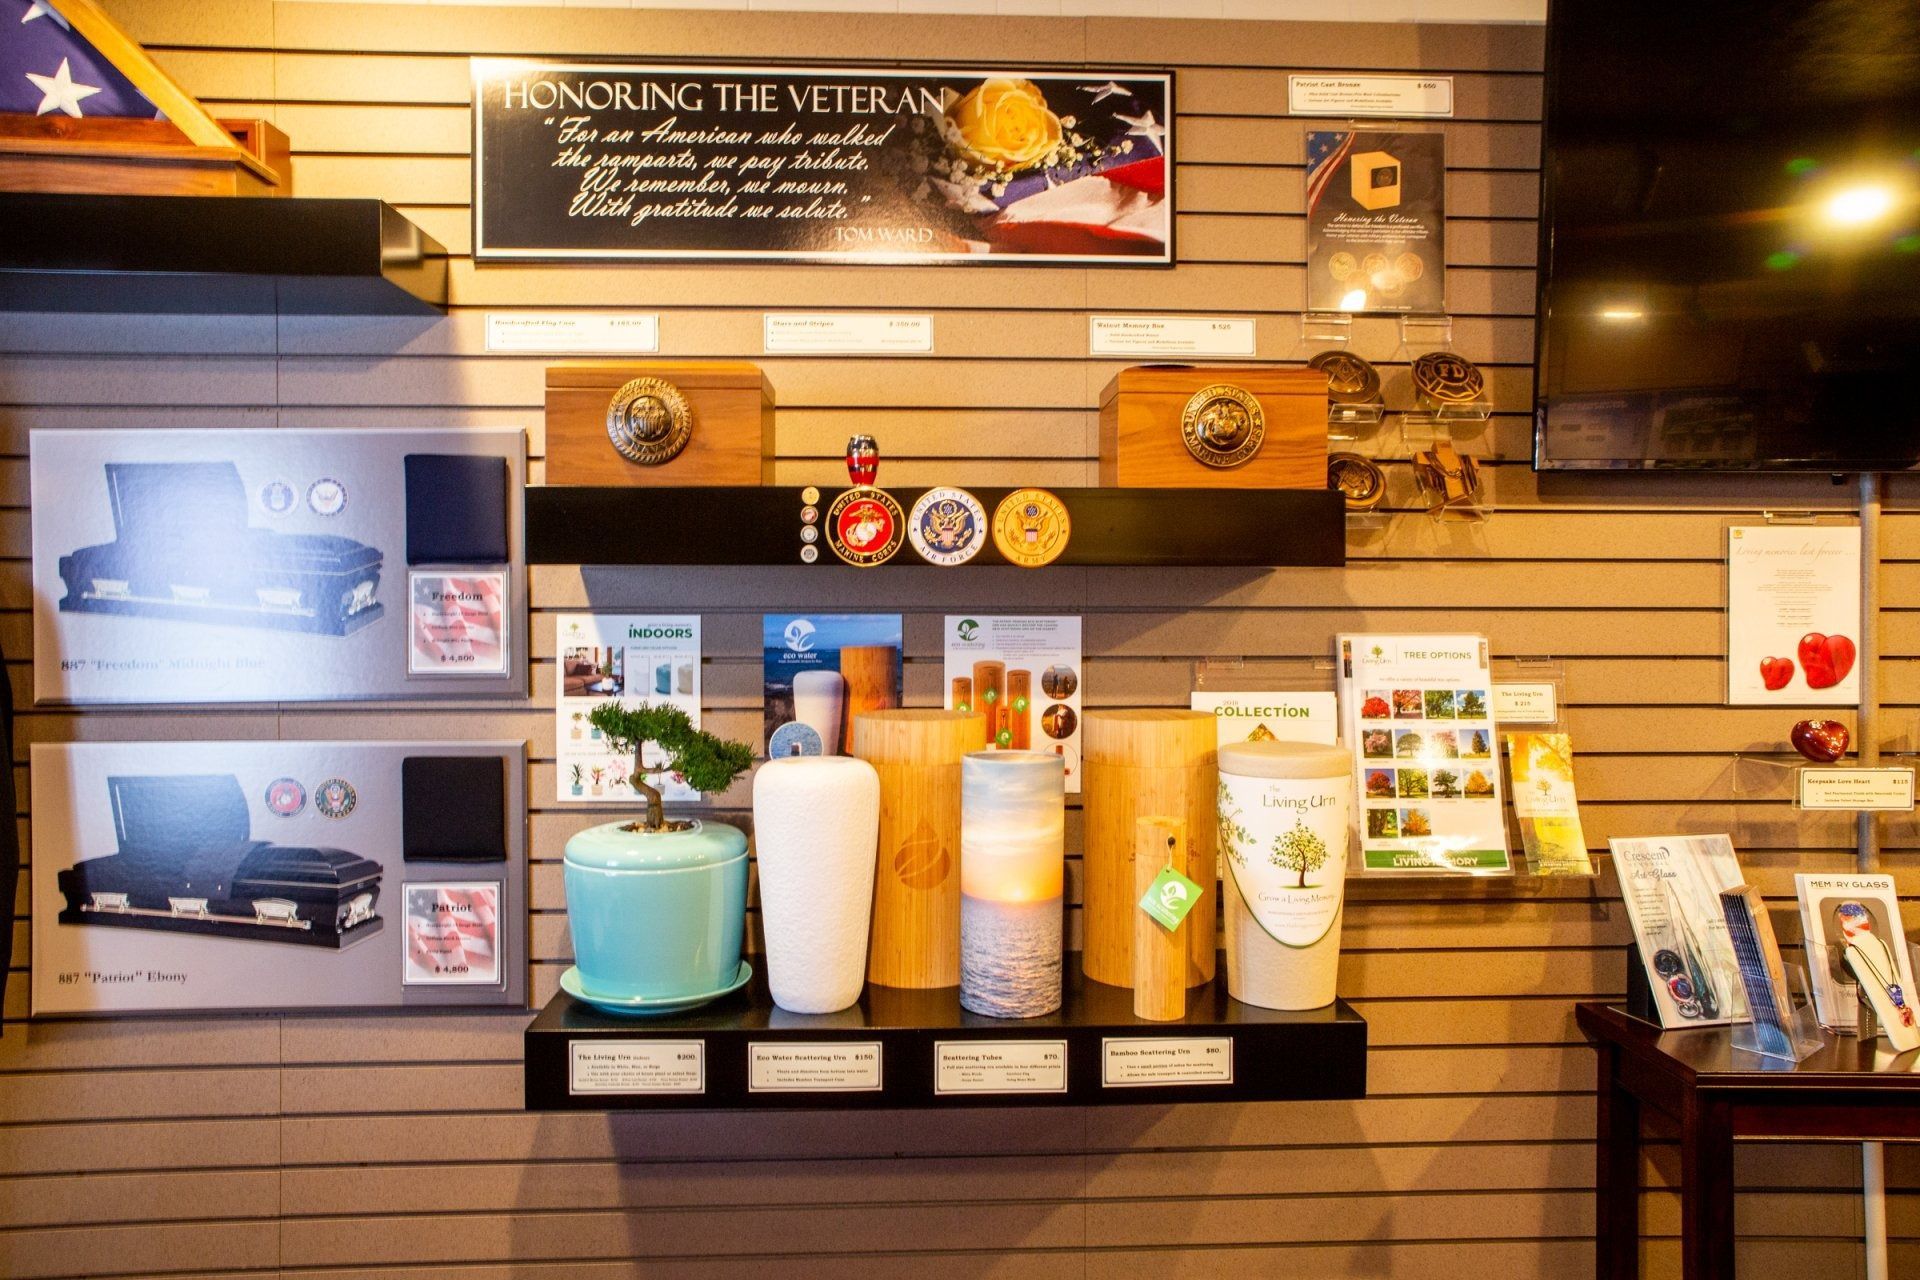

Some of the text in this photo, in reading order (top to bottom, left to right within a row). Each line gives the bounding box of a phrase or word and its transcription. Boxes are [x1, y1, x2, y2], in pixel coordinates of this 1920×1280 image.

[504, 80, 945, 115] HONORING THE VETERAN
[600, 130, 634, 144] an
[641, 116, 752, 146] American
[754, 121, 802, 146] who
[806, 122, 896, 147] walked
[552, 144, 869, 179] the ramparts, we pay tribute.
[580, 166, 849, 196] We remember, we mourn.
[568, 191, 636, 217] With
[631, 194, 738, 227] gratitude
[740, 204, 770, 219] we
[1333, 212, 1418, 225] Honoring the Veteran
[834, 227, 933, 243] TOM WARD
[1122, 322, 1150, 330] Memory
[1224, 386, 1259, 415] STATES
[1187, 429, 1262, 464] MARINE CORPS
[833, 491, 898, 516] UNITED STATES
[835, 539, 897, 563] MARINE CORPS
[942, 544, 978, 563] FORCE
[432, 591, 483, 601] Freedom
[1403, 651, 1472, 660] TREE OPTIONS
[61, 660, 86, 671] 887
[1263, 794, 1336, 814] Living Urn
[1393, 857, 1430, 867] LIVING
[1623, 850, 1667, 861] Crescent
[1648, 868, 1677, 880] Glass
[431, 903, 472, 912] Patriot
[58, 973, 80, 985] 887
[147, 971, 188, 985] Ebony
[593, 1054, 616, 1062] Living
[1140, 1049, 1176, 1057] Scattering
